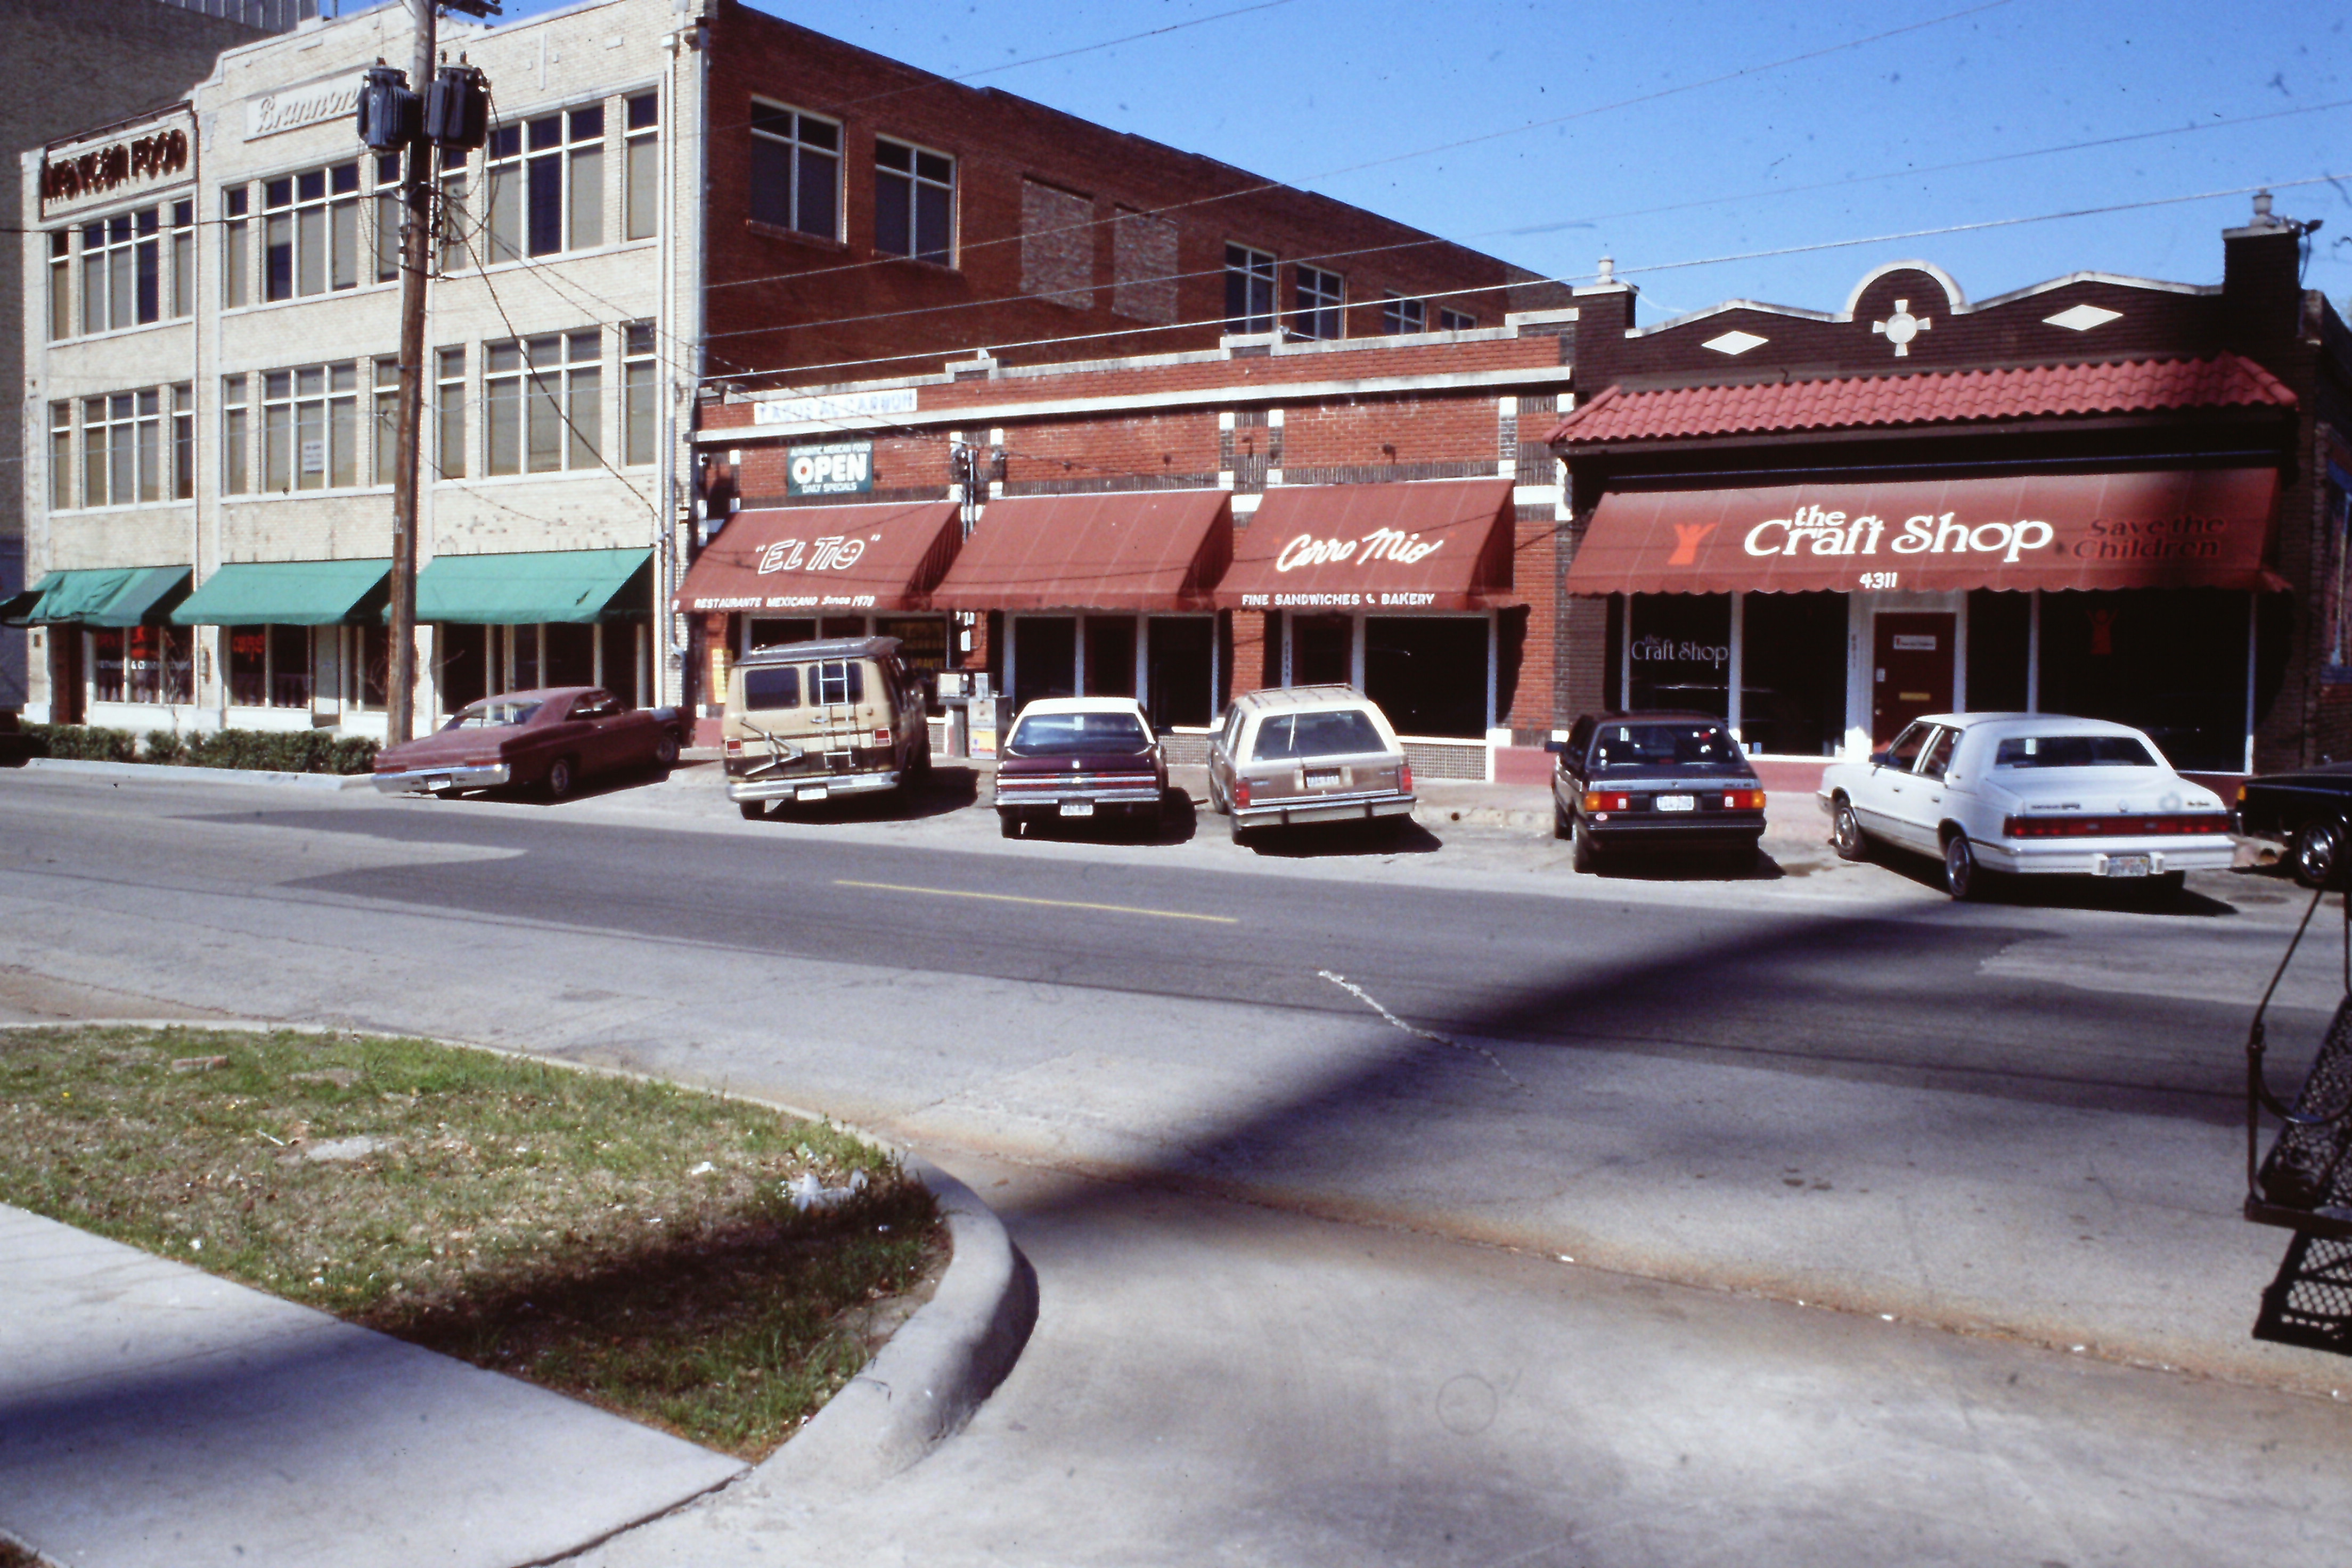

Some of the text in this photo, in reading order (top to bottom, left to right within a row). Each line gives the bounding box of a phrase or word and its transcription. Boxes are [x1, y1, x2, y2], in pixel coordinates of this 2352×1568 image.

[41, 129, 187, 200] MEXICAN FOOD
[759, 402, 813, 421] TACOS
[845, 393, 913, 414] CARBON
[823, 445, 851, 454] MEXICAN
[853, 443, 871, 452] FOOD
[793, 453, 867, 484] OPEN
[802, 482, 857, 493] DAILY SPECIALS
[1795, 505, 1846, 527] the
[2090, 515, 2225, 536] Save the
[1357, 528, 1444, 565] Mio
[1744, 512, 2053, 562] Craft Shop
[2073, 538, 2218, 559] Children
[1859, 573, 1898, 589] 4311
[695, 597, 762, 608] RESTAURANTE
[766, 596, 818, 607] MEXICANO
[821, 595, 851, 605] Since
[1242, 594, 1269, 606] FINE
[1275, 593, 1360, 606] SANDWICHES
[1381, 592, 1435, 605] BAKERY
[1632, 639, 1728, 669] Craft Shop
